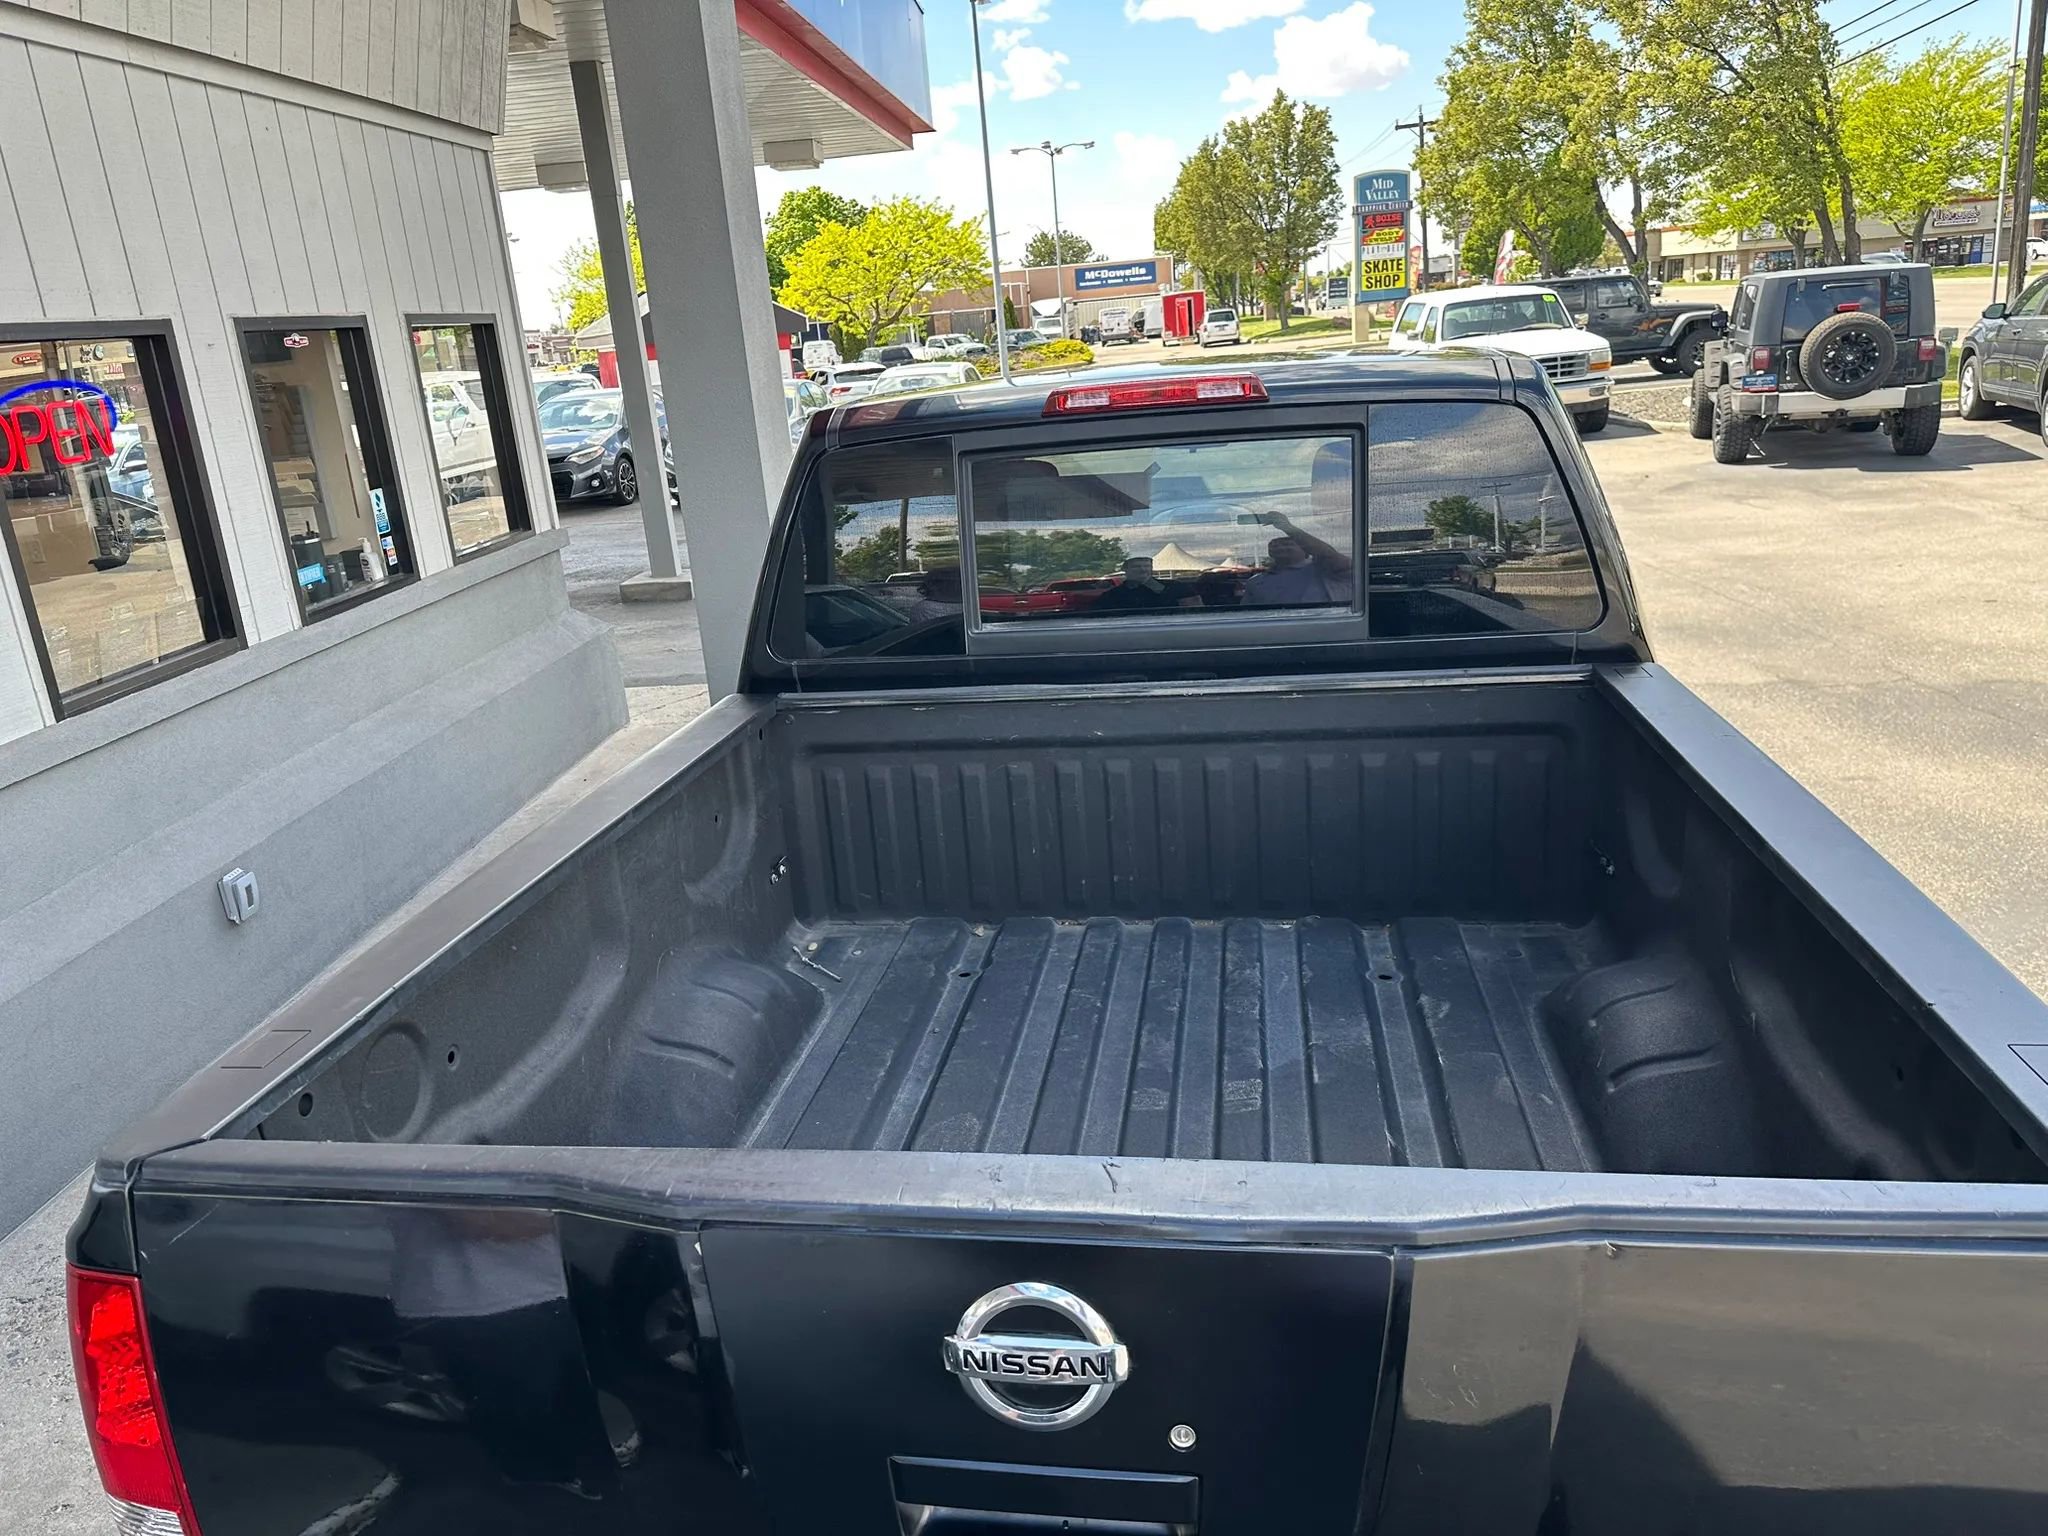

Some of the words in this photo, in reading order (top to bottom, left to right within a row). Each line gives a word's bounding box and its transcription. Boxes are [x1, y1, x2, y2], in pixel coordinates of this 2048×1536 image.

[1372, 178, 1394, 189] MID
[1365, 189, 1400, 201] VALLEY
[1084, 266, 1147, 280] McDowells
[1364, 258, 1403, 274] SKATE
[1365, 274, 1400, 289] SHOP
[962, 1349, 1108, 1378] NISSAN
